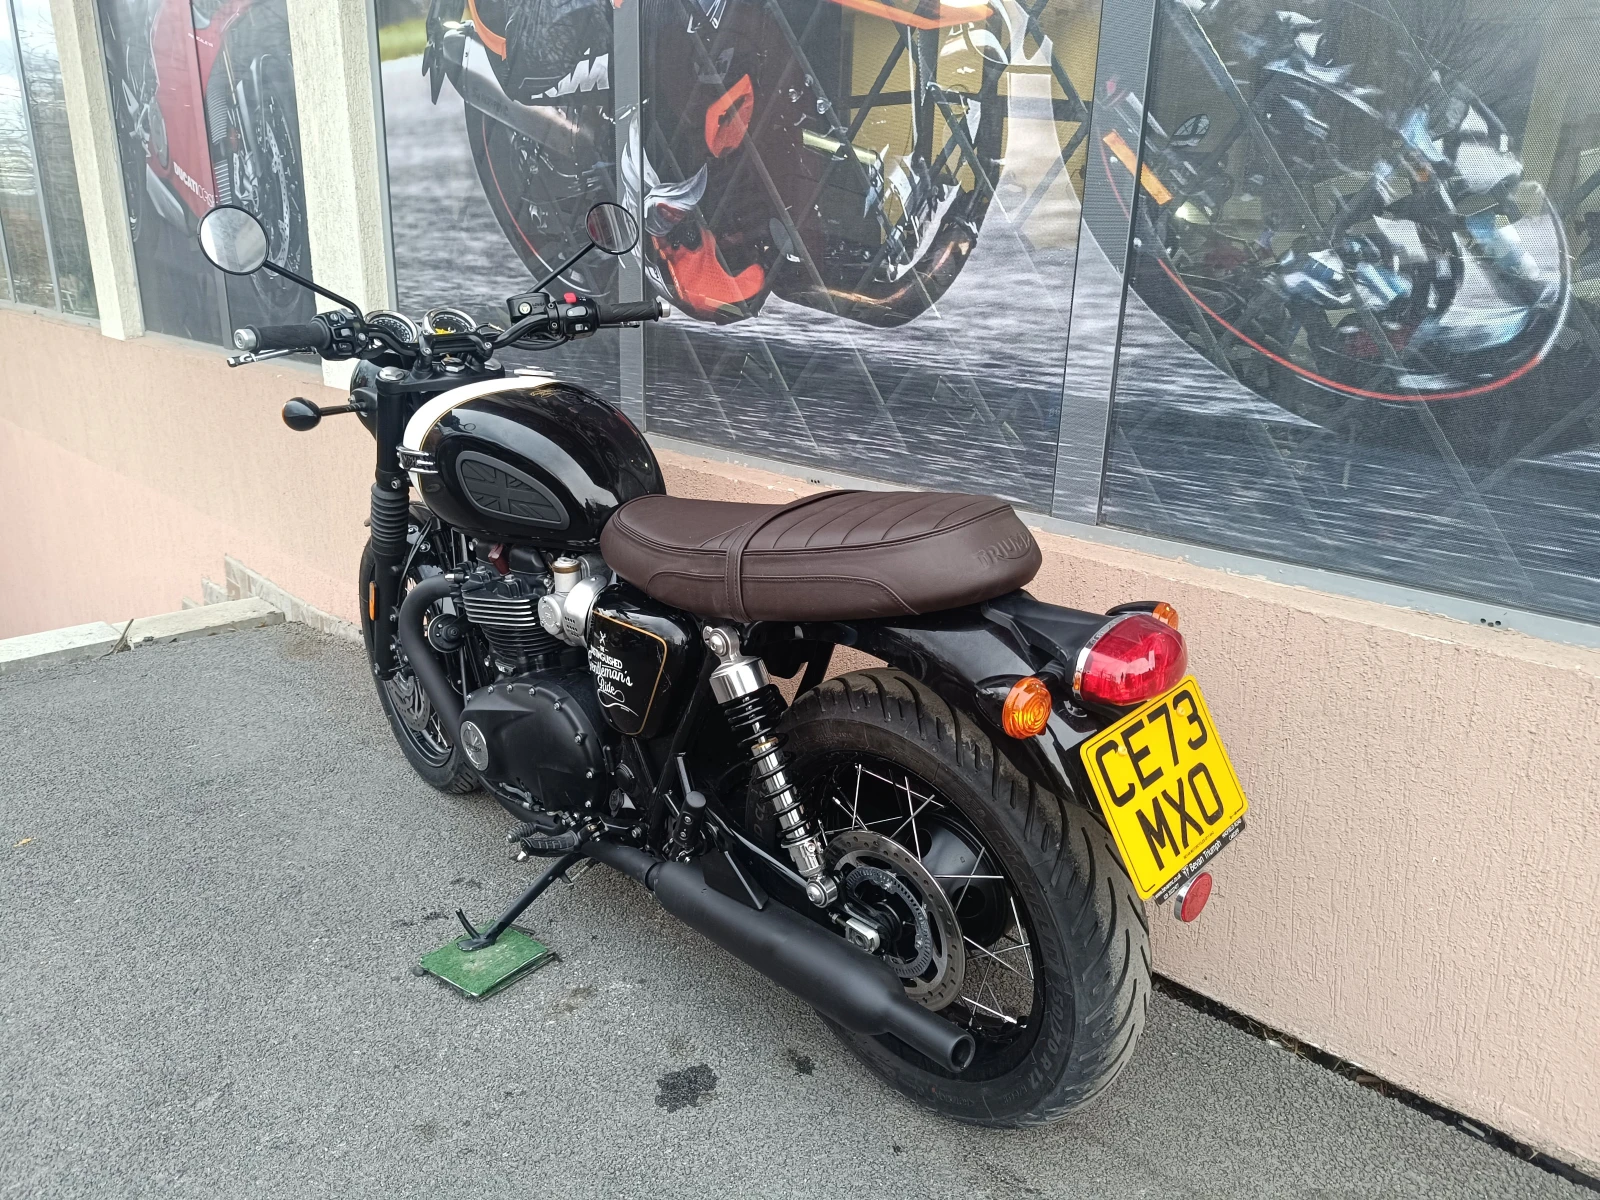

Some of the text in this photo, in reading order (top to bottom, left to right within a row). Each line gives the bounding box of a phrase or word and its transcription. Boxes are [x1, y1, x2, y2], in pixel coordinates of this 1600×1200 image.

[974, 530, 1031, 569] TRIUMP
[1095, 689, 1208, 808] CE73
[1135, 762, 1224, 871] MXO
[1189, 840, 1222, 872] Bevan Triumph
